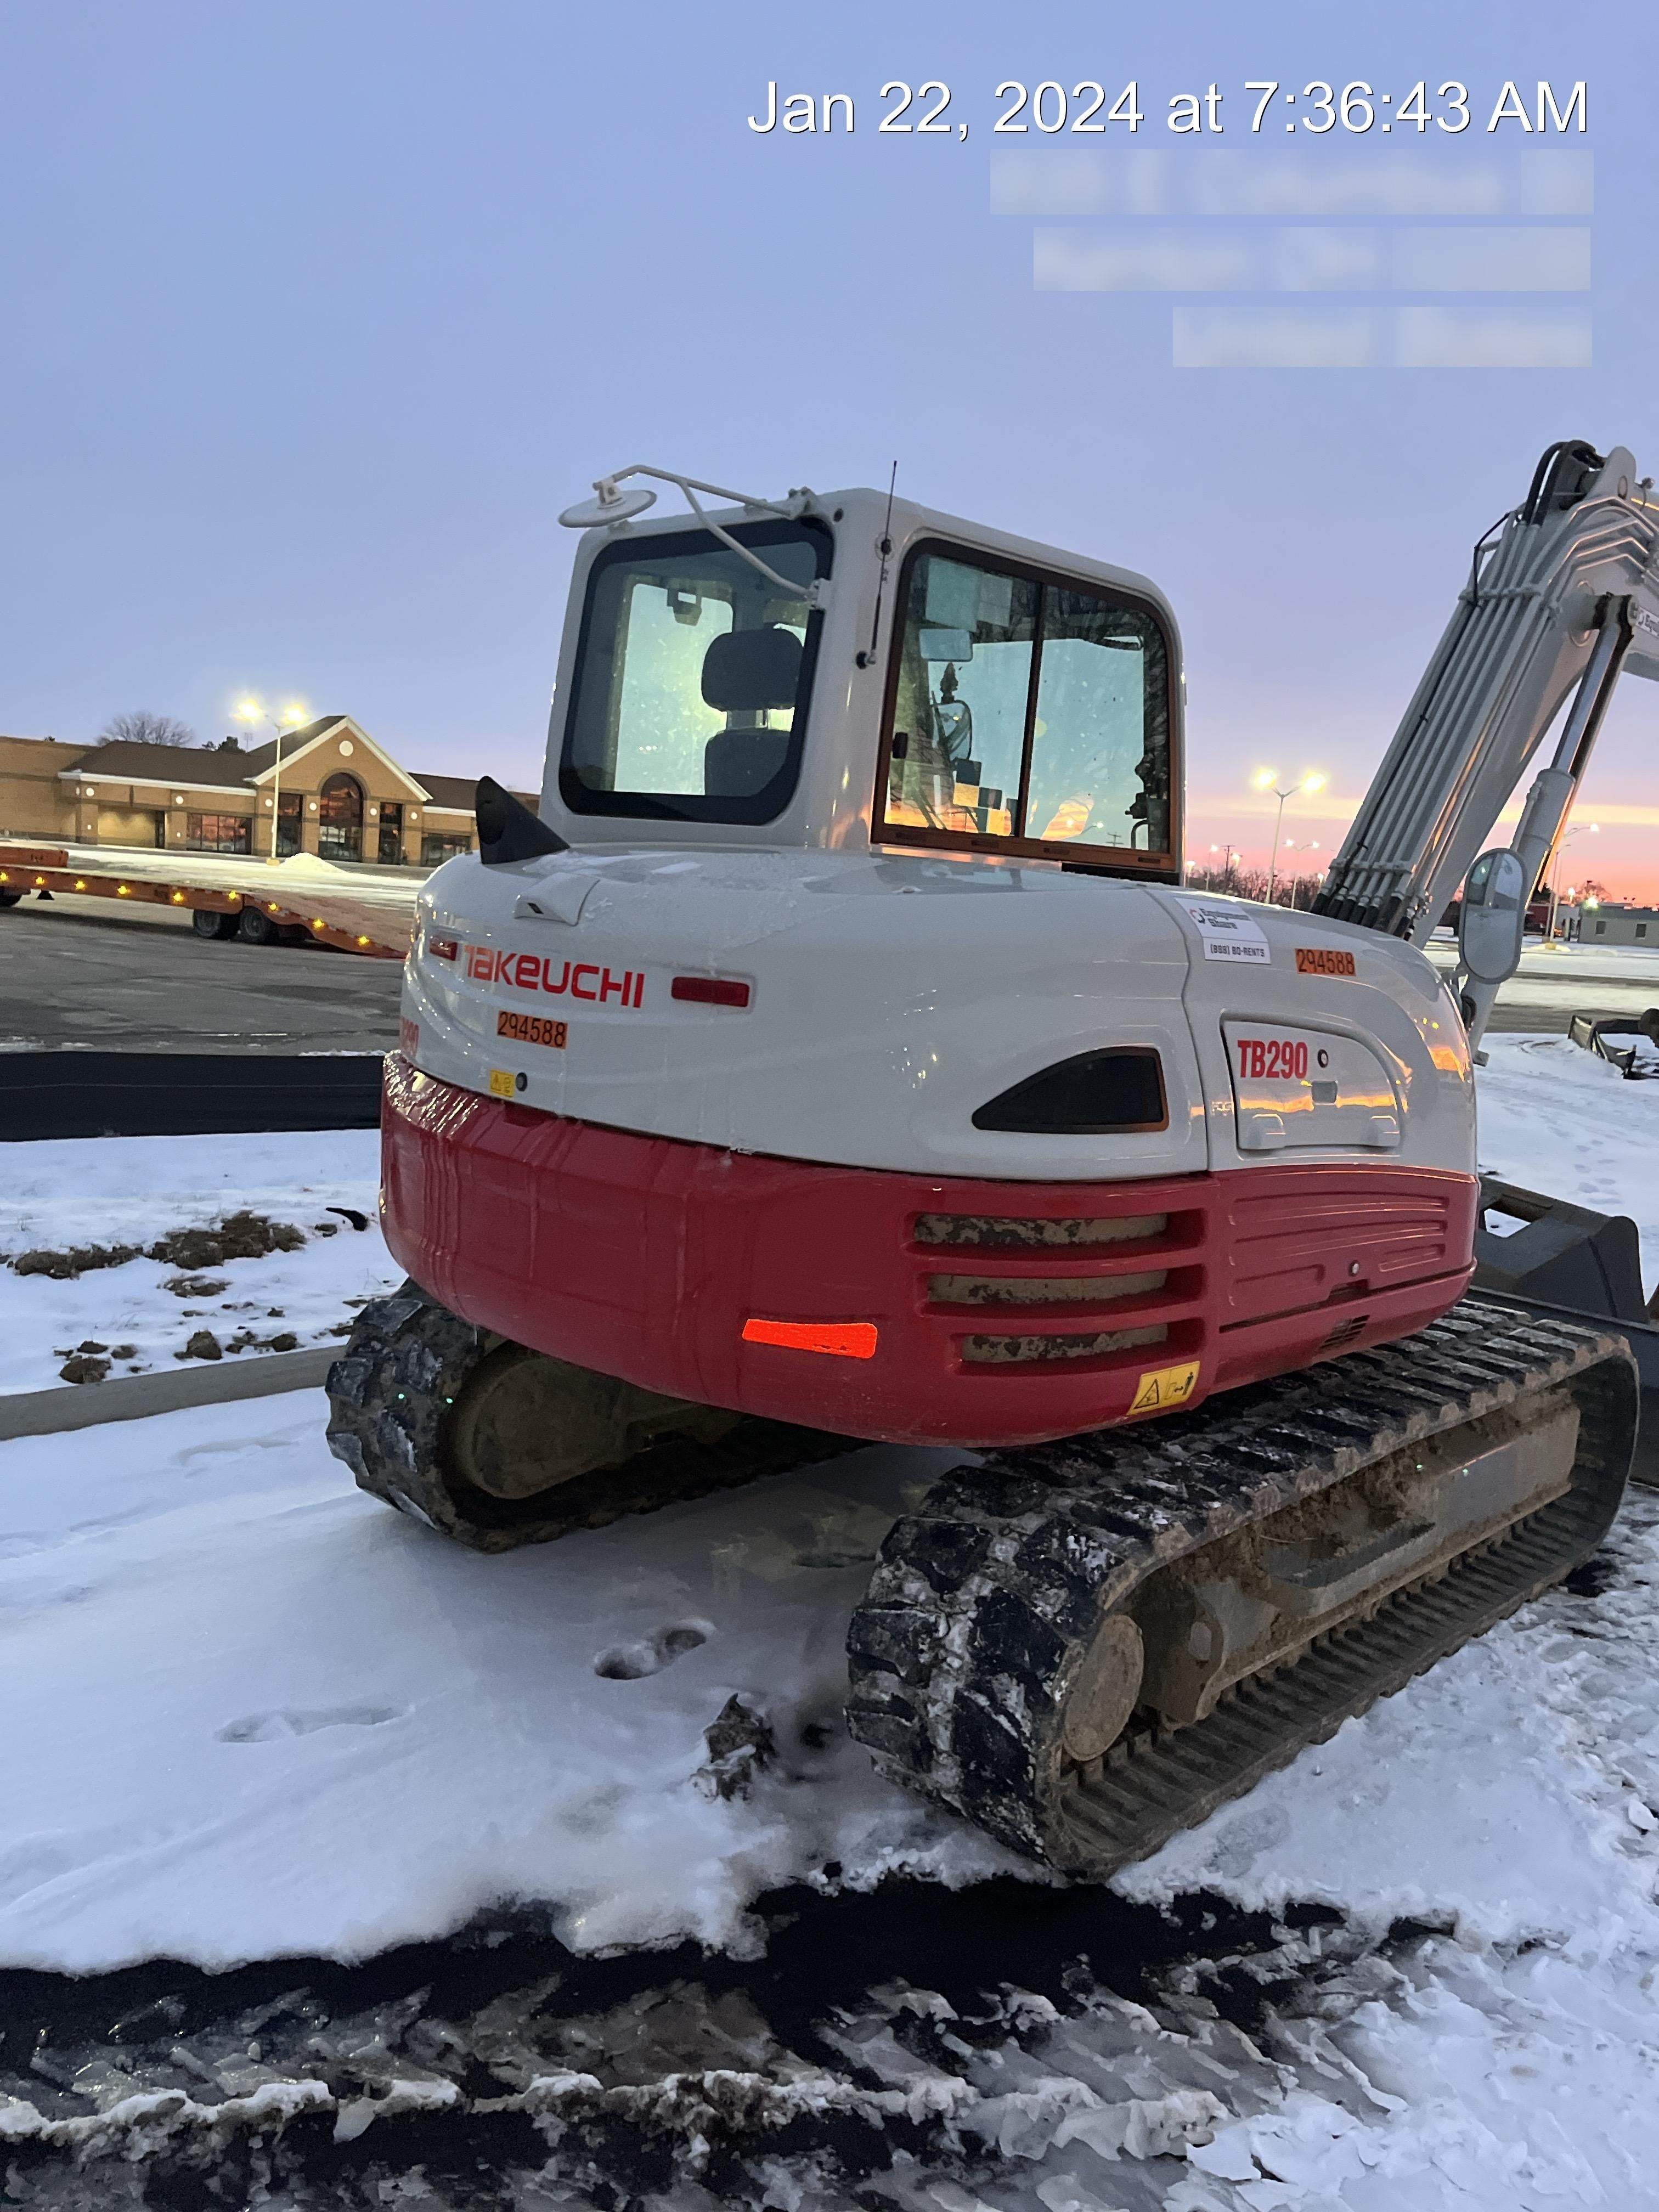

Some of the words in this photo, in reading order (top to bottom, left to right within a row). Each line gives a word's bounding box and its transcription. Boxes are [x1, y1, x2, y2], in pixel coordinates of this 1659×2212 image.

[1296, 949, 1355, 975] 294588
[497, 1011, 567, 1047] 294588
[1237, 1040, 1308, 1079] TB290
